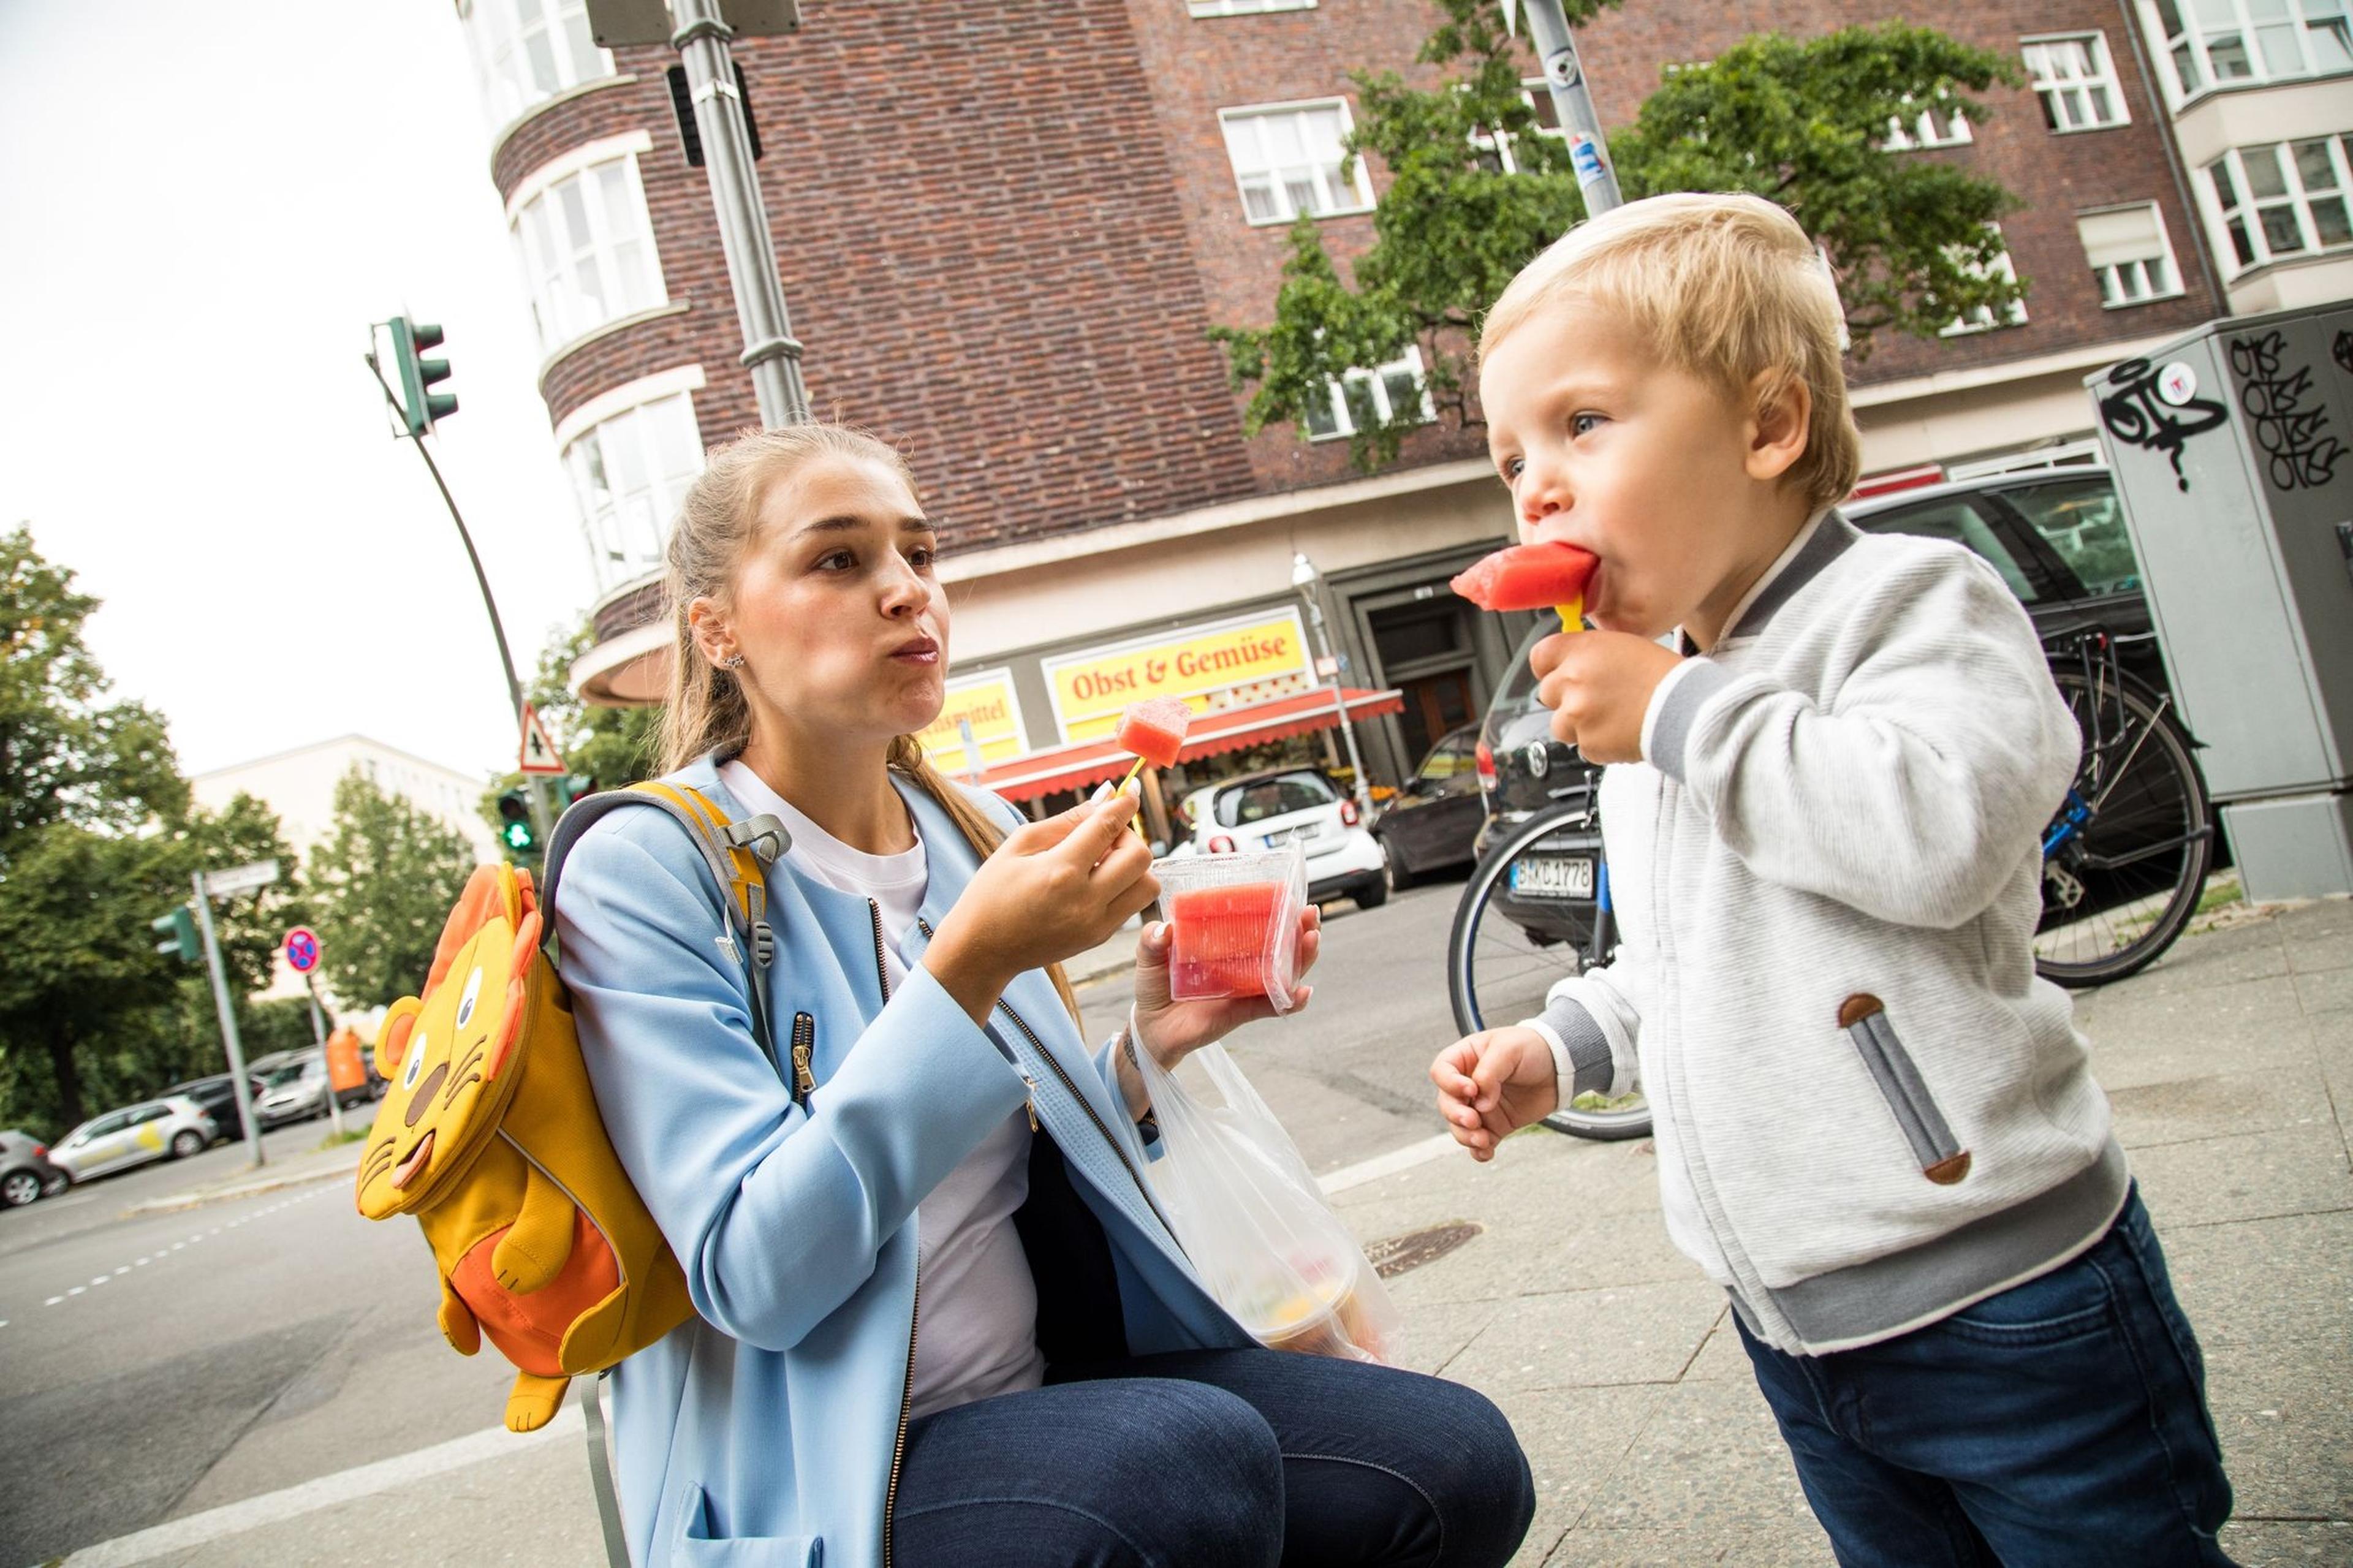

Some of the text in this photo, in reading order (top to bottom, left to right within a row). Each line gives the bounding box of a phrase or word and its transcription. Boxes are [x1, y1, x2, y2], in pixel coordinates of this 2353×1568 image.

[1072, 635, 1288, 700] Obst & Gemüse
